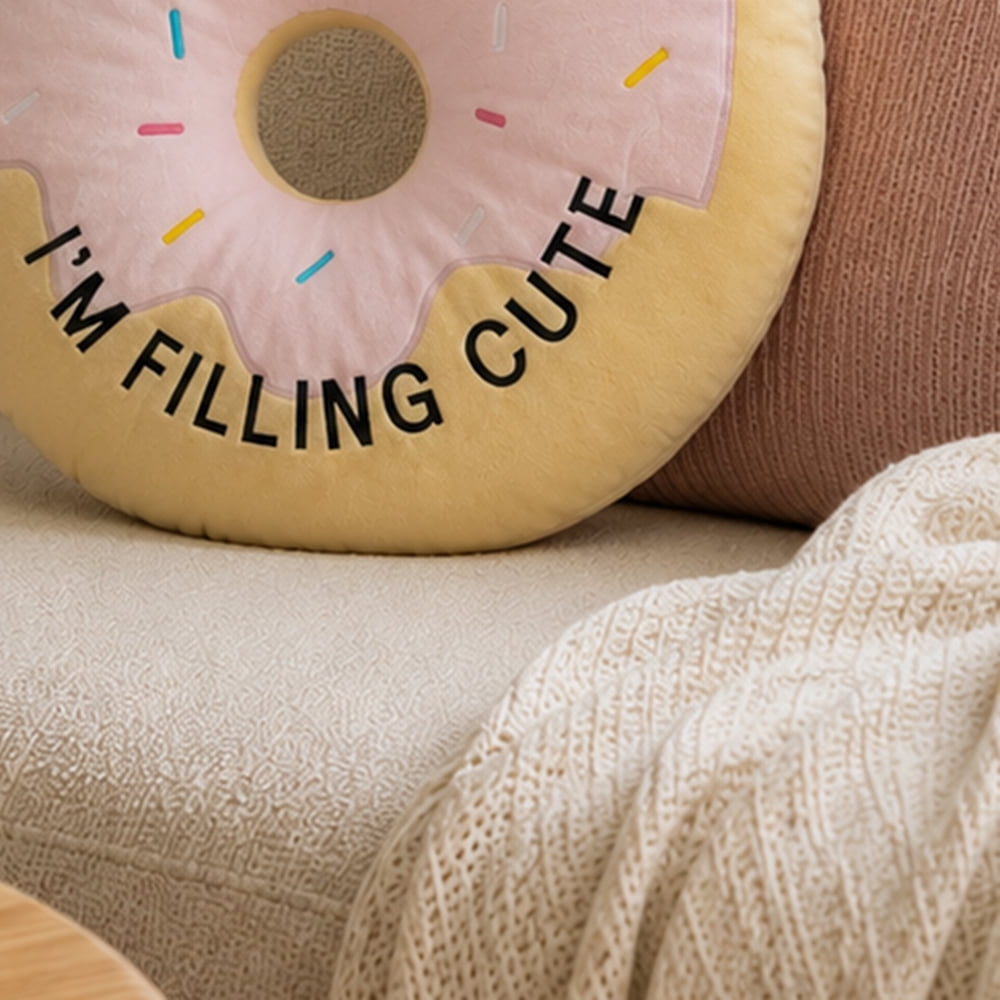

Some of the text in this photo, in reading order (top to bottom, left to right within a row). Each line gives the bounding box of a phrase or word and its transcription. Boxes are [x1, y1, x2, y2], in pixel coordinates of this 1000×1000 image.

[23, 175, 646, 452] I'M FILLING CUTE
